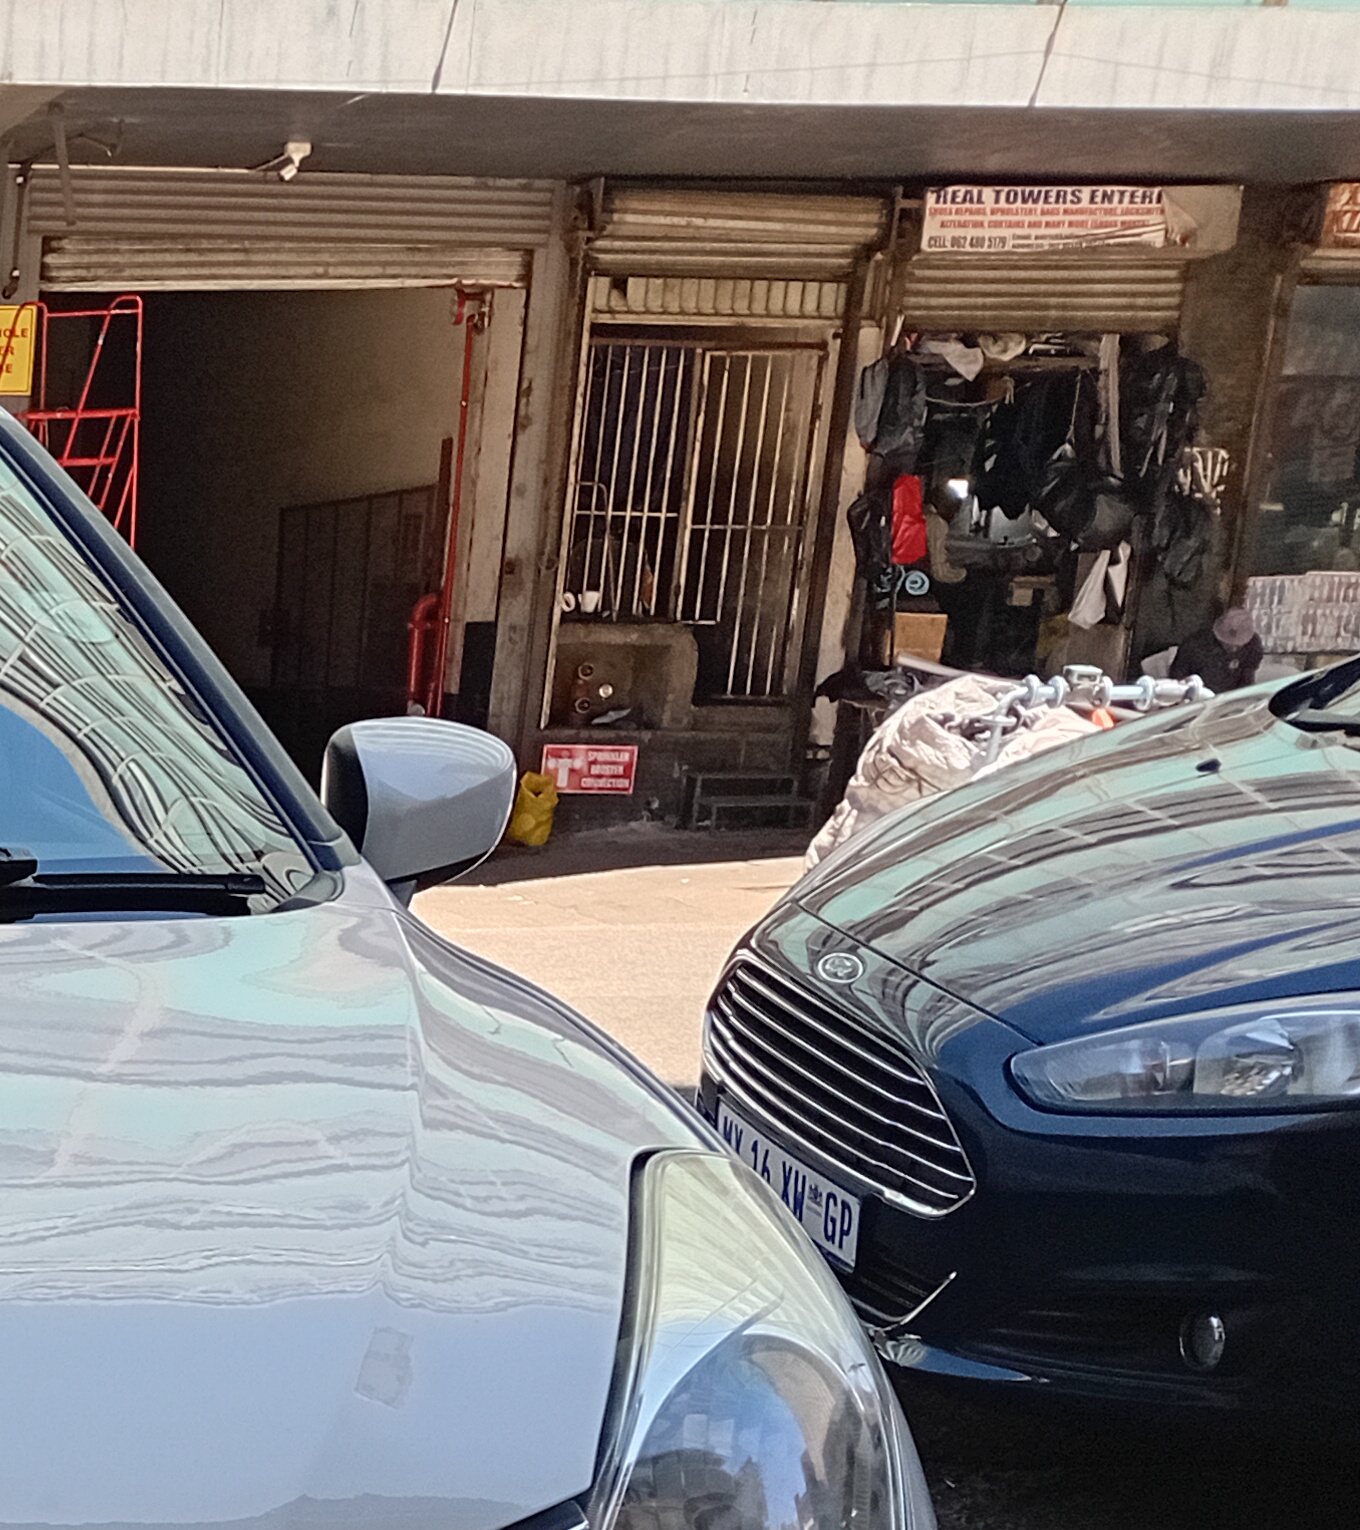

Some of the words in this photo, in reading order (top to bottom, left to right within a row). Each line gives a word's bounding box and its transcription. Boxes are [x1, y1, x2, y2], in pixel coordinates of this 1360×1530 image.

[931, 188, 985, 205] REAL
[993, 188, 1083, 205] TOWERS
[751, 1139, 771, 1184] 16
[823, 1191, 853, 1250] GP
